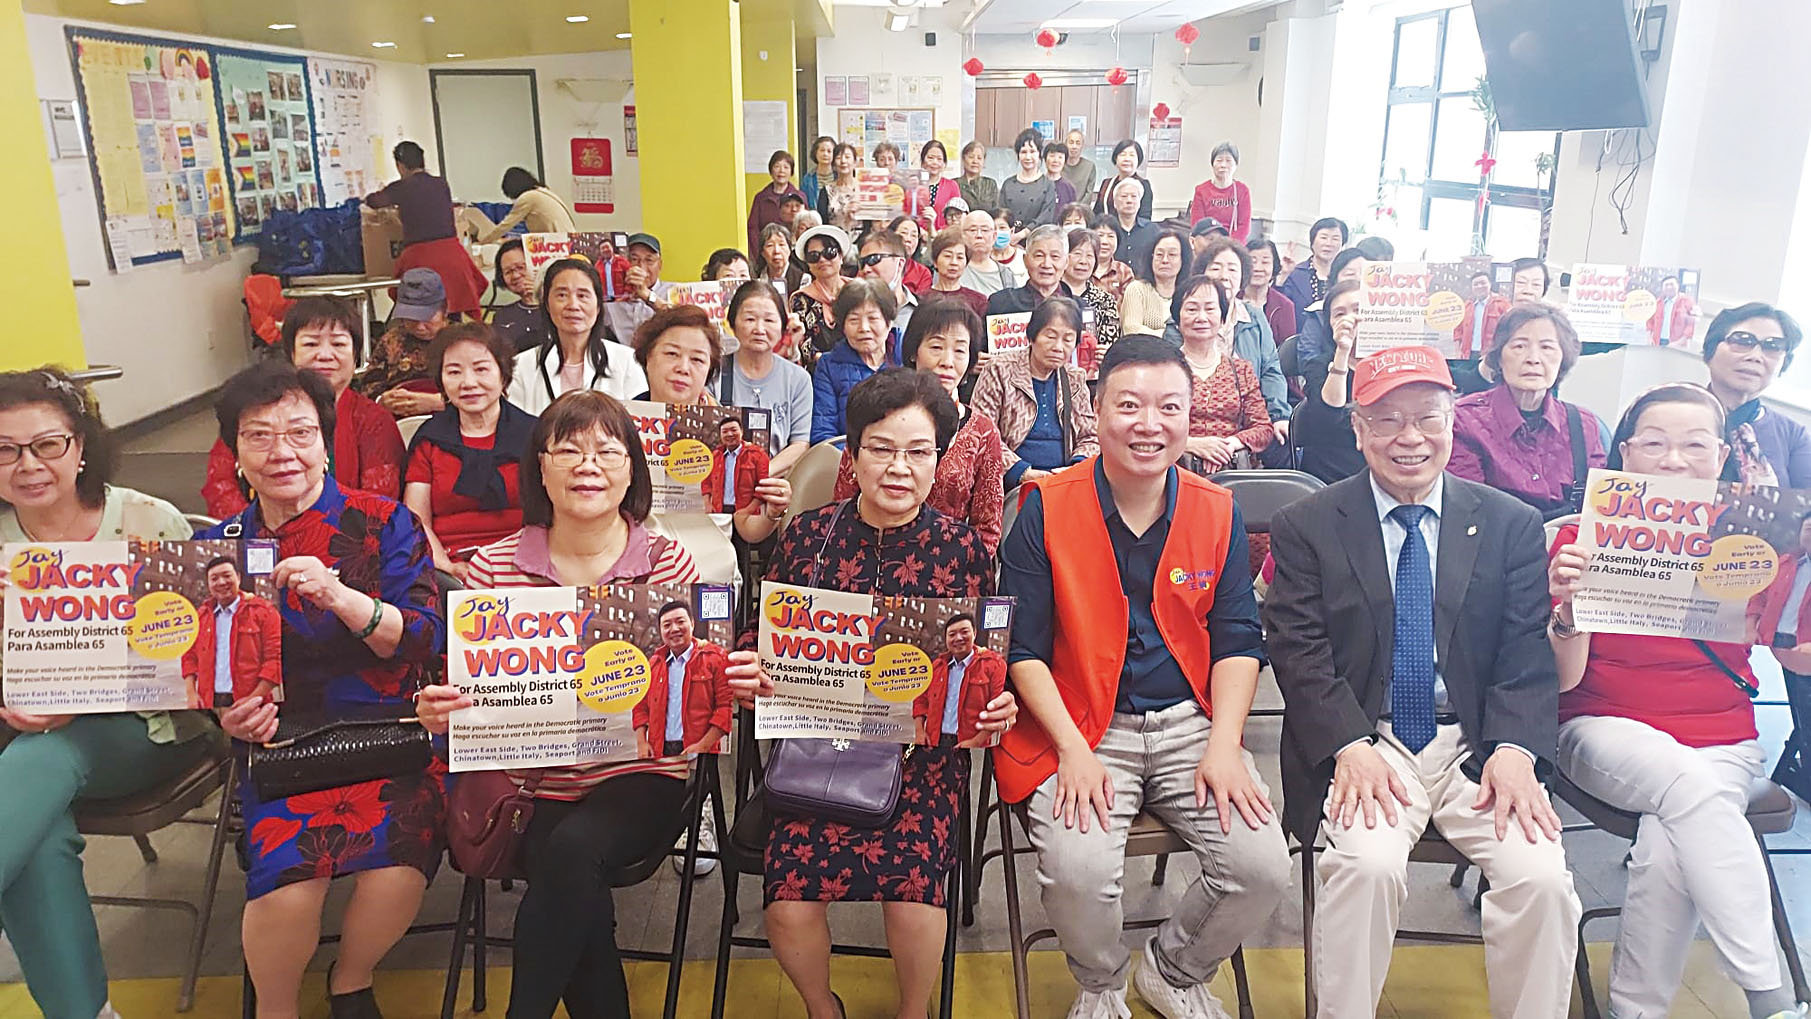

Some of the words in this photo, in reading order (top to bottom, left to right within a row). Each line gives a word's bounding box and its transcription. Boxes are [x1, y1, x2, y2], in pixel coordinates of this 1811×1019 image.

[528, 241, 575, 253] JACKY
[1367, 273, 1434, 288] JACKY
[1577, 274, 1630, 288] JACKY
[1367, 292, 1430, 307] WONG
[1575, 289, 1627, 302] WONG
[1371, 309, 1398, 317] Assembly
[994, 322, 1029, 335] JACK
[994, 336, 1028, 349] WON
[641, 438, 671, 456] NG
[674, 458, 694, 466] JUNE
[696, 455, 710, 463] 23
[1597, 478, 1649, 498] Jay
[1597, 493, 1731, 527] JACKY
[1595, 522, 1712, 557] WONG
[14, 549, 67, 568] Jay
[1597, 552, 1648, 568] Assembly
[1650, 557, 1690, 570] District
[1691, 562, 1704, 572] 65
[1713, 561, 1746, 571] JUNE
[1749, 560, 1773, 569] 23
[17, 561, 144, 591] JACKY
[1588, 564, 1600, 573] ra
[1601, 565, 1656, 580] Asamblea
[1658, 570, 1672, 581] 65
[20, 593, 136, 622] WONG
[460, 596, 515, 618] Jay
[770, 591, 817, 609] Jay
[141, 619, 171, 633] JUNE
[173, 614, 193, 626] 23
[461, 609, 594, 641] JACKY
[771, 605, 886, 637] JACKY
[8, 628, 24, 638] For
[28, 626, 80, 641] Assembly
[82, 626, 119, 637] District
[121, 625, 134, 636] 65
[8, 641, 32, 652] Para
[35, 638, 89, 651] Asamblea
[92, 640, 105, 649] 65
[771, 632, 875, 665] WONG
[463, 644, 586, 677] WONG
[605, 657, 627, 667] Early
[590, 670, 622, 686] JUNE
[624, 665, 646, 678] 23
[761, 659, 775, 670] For
[776, 662, 822, 677] Assembly
[824, 667, 857, 678] District
[859, 670, 871, 680] 65
[878, 667, 907, 679] JUNE
[909, 665, 928, 675] 23
[473, 680, 527, 696] Assembly
[529, 678, 568, 691] District
[569, 678, 582, 689] 65
[584, 688, 603, 697] Vote
[604, 678, 646, 692] Temprano
[782, 673, 831, 688] Asamblea
[832, 679, 844, 689] 65
[890, 676, 928, 684] Temprano
[481, 696, 537, 707] Asamblea
[540, 694, 553, 705] 65
[604, 691, 627, 701] Junio
[628, 687, 639, 695] 23
[803, 695, 819, 703] heard
[836, 699, 867, 708] Democratic
[867, 703, 890, 711] primary
[453, 723, 471, 731] Make
[472, 724, 487, 732] your
[506, 722, 525, 730] heard
[546, 719, 581, 728] Democratic
[582, 717, 607, 725] primary
[829, 717, 856, 727] Bridges,
[833, 724, 860, 734] Seaport
[539, 729, 564, 737] primaria
[499, 745, 518, 753] Side,
[538, 743, 570, 751] Bridges,
[571, 741, 594, 749] Grand
[521, 752, 543, 760] Italy,
[545, 750, 575, 759] Seaport
